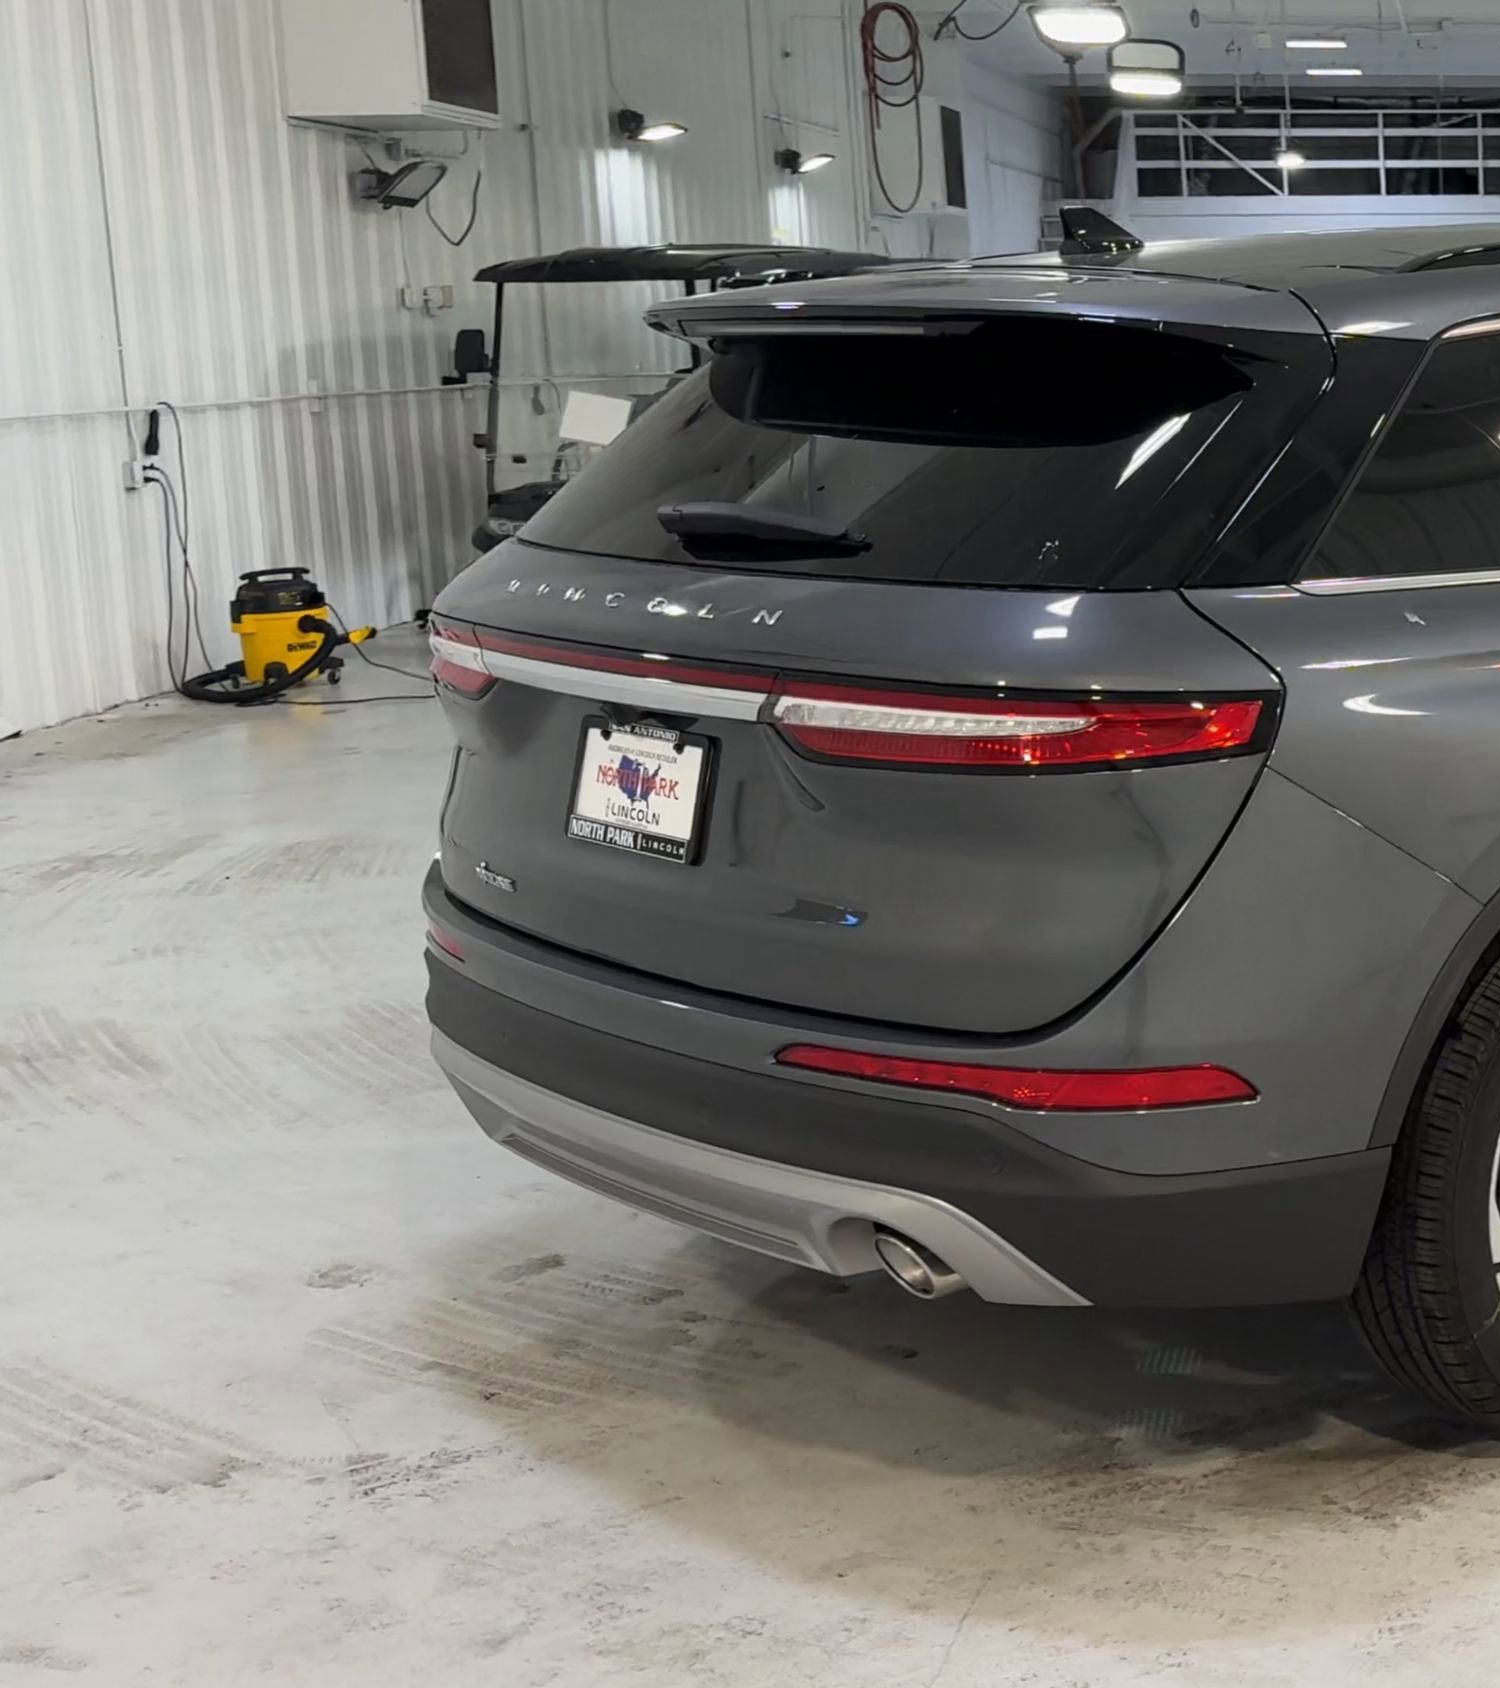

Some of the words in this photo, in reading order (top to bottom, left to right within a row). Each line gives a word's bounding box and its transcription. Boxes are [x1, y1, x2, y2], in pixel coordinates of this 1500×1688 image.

[632, 725, 676, 741] ANTONIO
[596, 764, 639, 791] NORTH
[641, 773, 679, 801] PARK
[611, 802, 660, 827] LINCOLN
[570, 818, 605, 841] NORTH
[606, 826, 635, 849] PARK
[642, 839, 684, 855] LINCOLN
